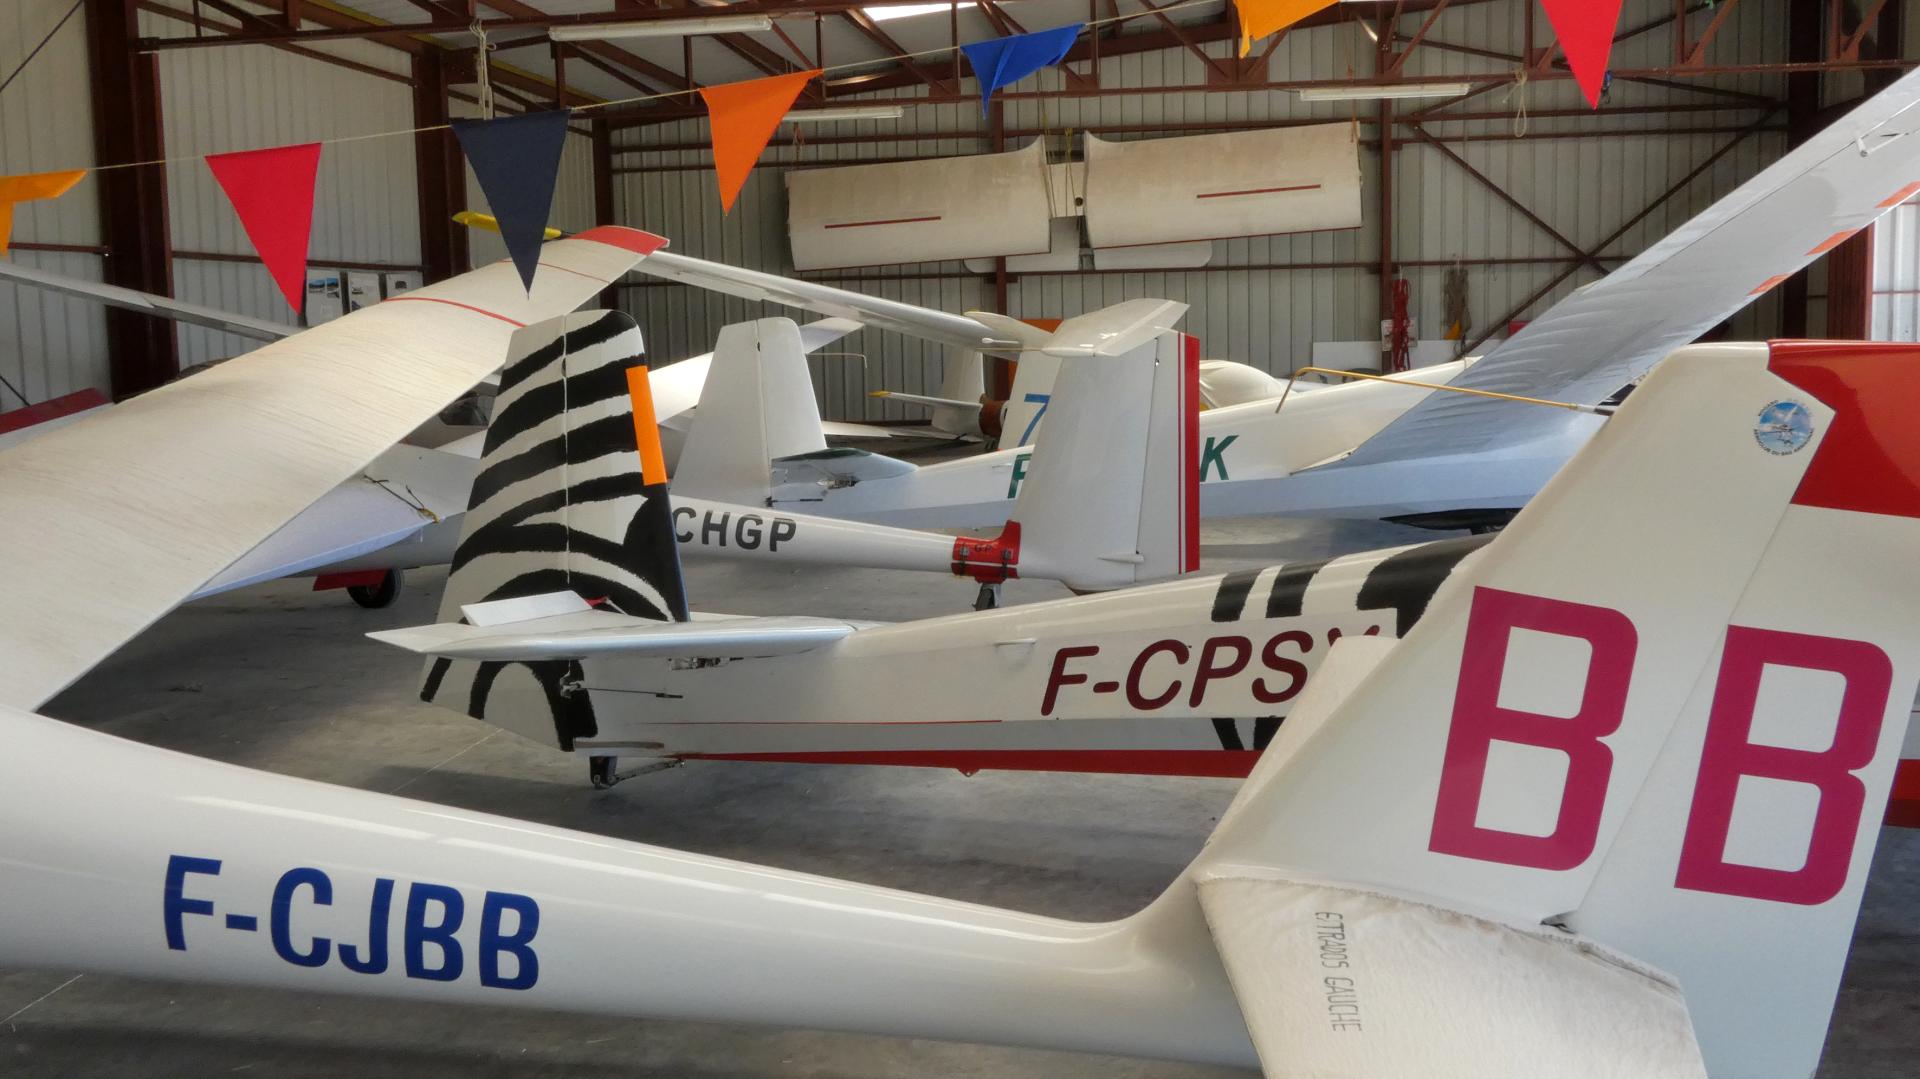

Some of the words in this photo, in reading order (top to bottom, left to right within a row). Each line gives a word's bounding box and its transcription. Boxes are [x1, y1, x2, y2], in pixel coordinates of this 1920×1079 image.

[1041, 624, 1380, 716] F-CPS
[163, 854, 541, 991] F-CJBB
[1324, 976, 1362, 1031] GAUCHE
